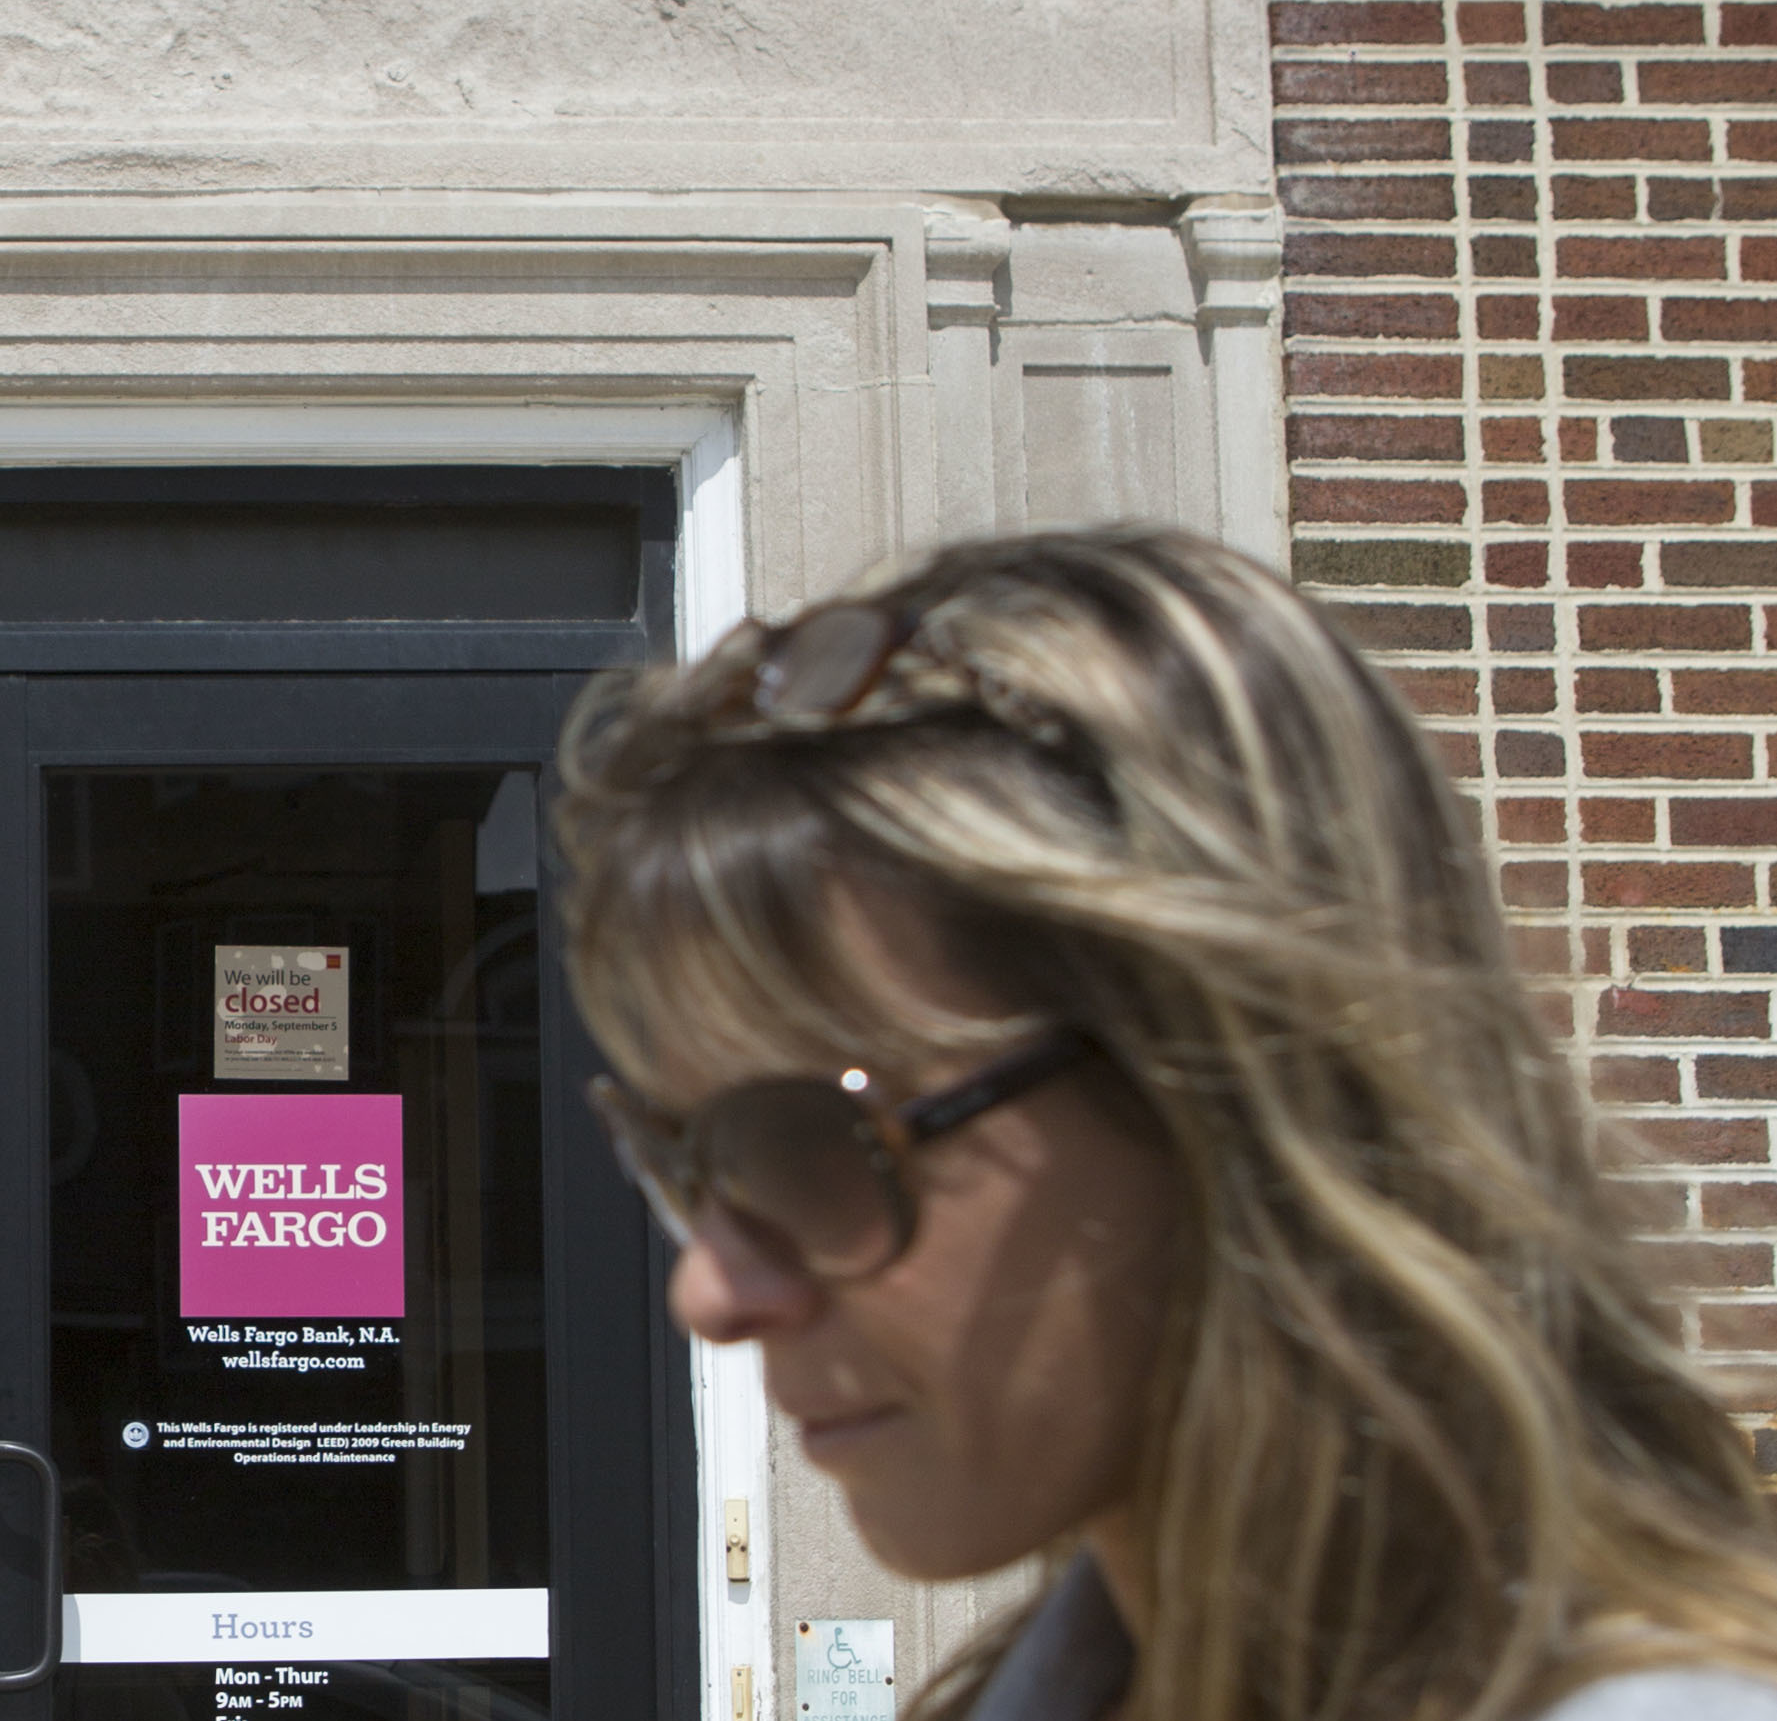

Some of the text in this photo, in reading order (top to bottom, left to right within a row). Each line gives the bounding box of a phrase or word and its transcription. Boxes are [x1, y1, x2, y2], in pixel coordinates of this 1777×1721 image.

[224, 970, 311, 986] We will be
[225, 987, 319, 1013] closed
[225, 1021, 337, 1033] Monday, September 5
[225, 1034, 277, 1045] Labor Day
[195, 1164, 387, 1199] WELLS
[202, 1211, 386, 1247] FARGO
[187, 1325, 400, 1346] Wells Fargo Bank, N.A.
[222, 1351, 365, 1372] wellsfargo.com
[157, 1422, 471, 1435] This Wells Fargo is registered under Leadership in Energy
[163, 1437, 185, 1447] and
[187, 1437, 270, 1447] Environmental
[272, 1438, 311, 1450] Design
[352, 1438, 379, 1447] 2009
[381, 1437, 415, 1447] Green
[417, 1437, 464, 1450] Building
[234, 1452, 395, 1464] Operations and Maintenance
[212, 1614, 313, 1639] Hours
[216, 1668, 260, 1684] Mon
[275, 1667, 328, 1684] Thur:
[808, 1669, 882, 1684] RING BELL
[216, 1692, 252, 1708] 9AM
[268, 1692, 302, 1708] 5PM
[832, 1691, 857, 1706] FOR
